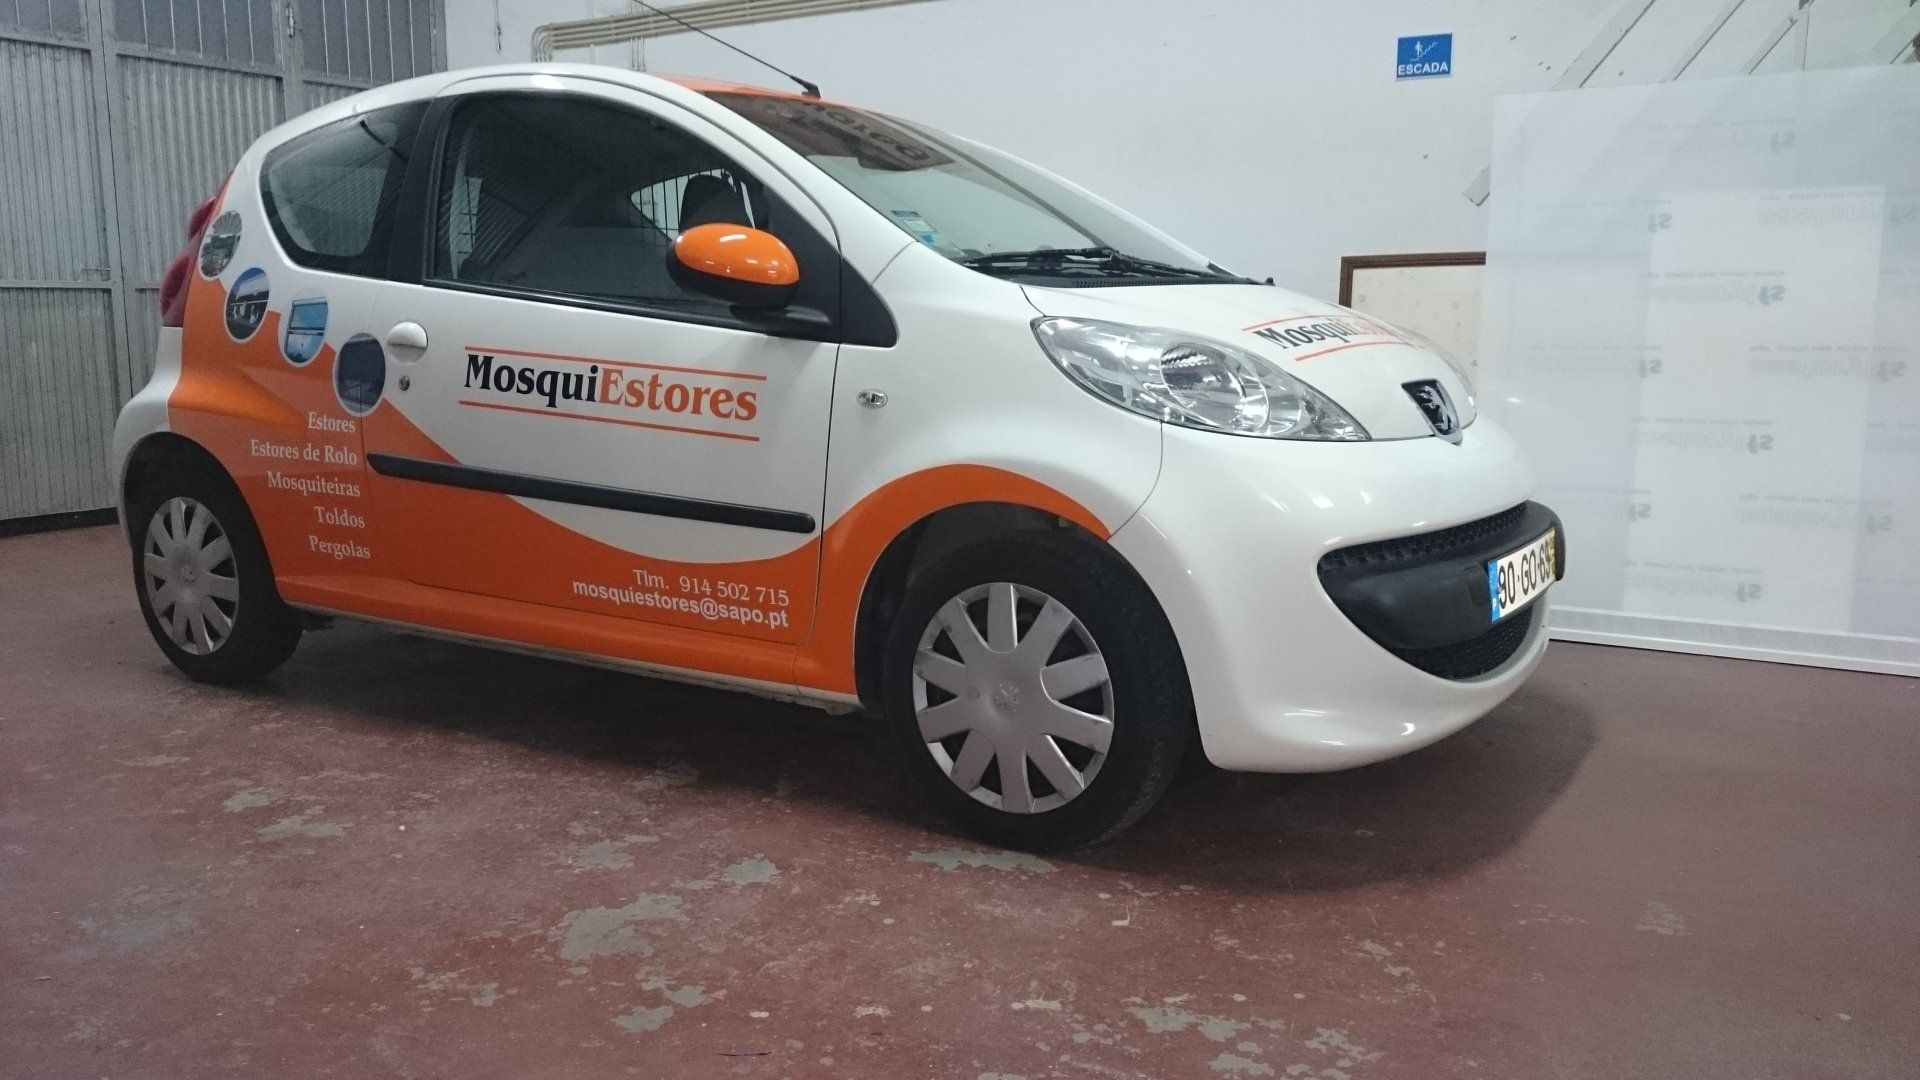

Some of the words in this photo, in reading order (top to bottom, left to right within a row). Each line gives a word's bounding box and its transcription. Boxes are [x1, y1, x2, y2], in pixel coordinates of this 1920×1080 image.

[1398, 62, 1448, 76] ESCADA
[464, 354, 758, 421] MosquiEstores
[307, 411, 356, 433] Estores
[250, 439, 299, 460] Estores
[303, 442, 320, 462] de
[324, 445, 358, 466] Rolo
[266, 470, 361, 497] Mosquiteiras
[314, 506, 366, 529] Toldos
[308, 534, 371, 560] Pergolas
[632, 569, 669, 590] Tlm.
[679, 576, 712, 595] 914
[717, 581, 750, 601] 502
[756, 586, 789, 606] 715
[572, 580, 789, 629] mosquiestores@sapo.pt
